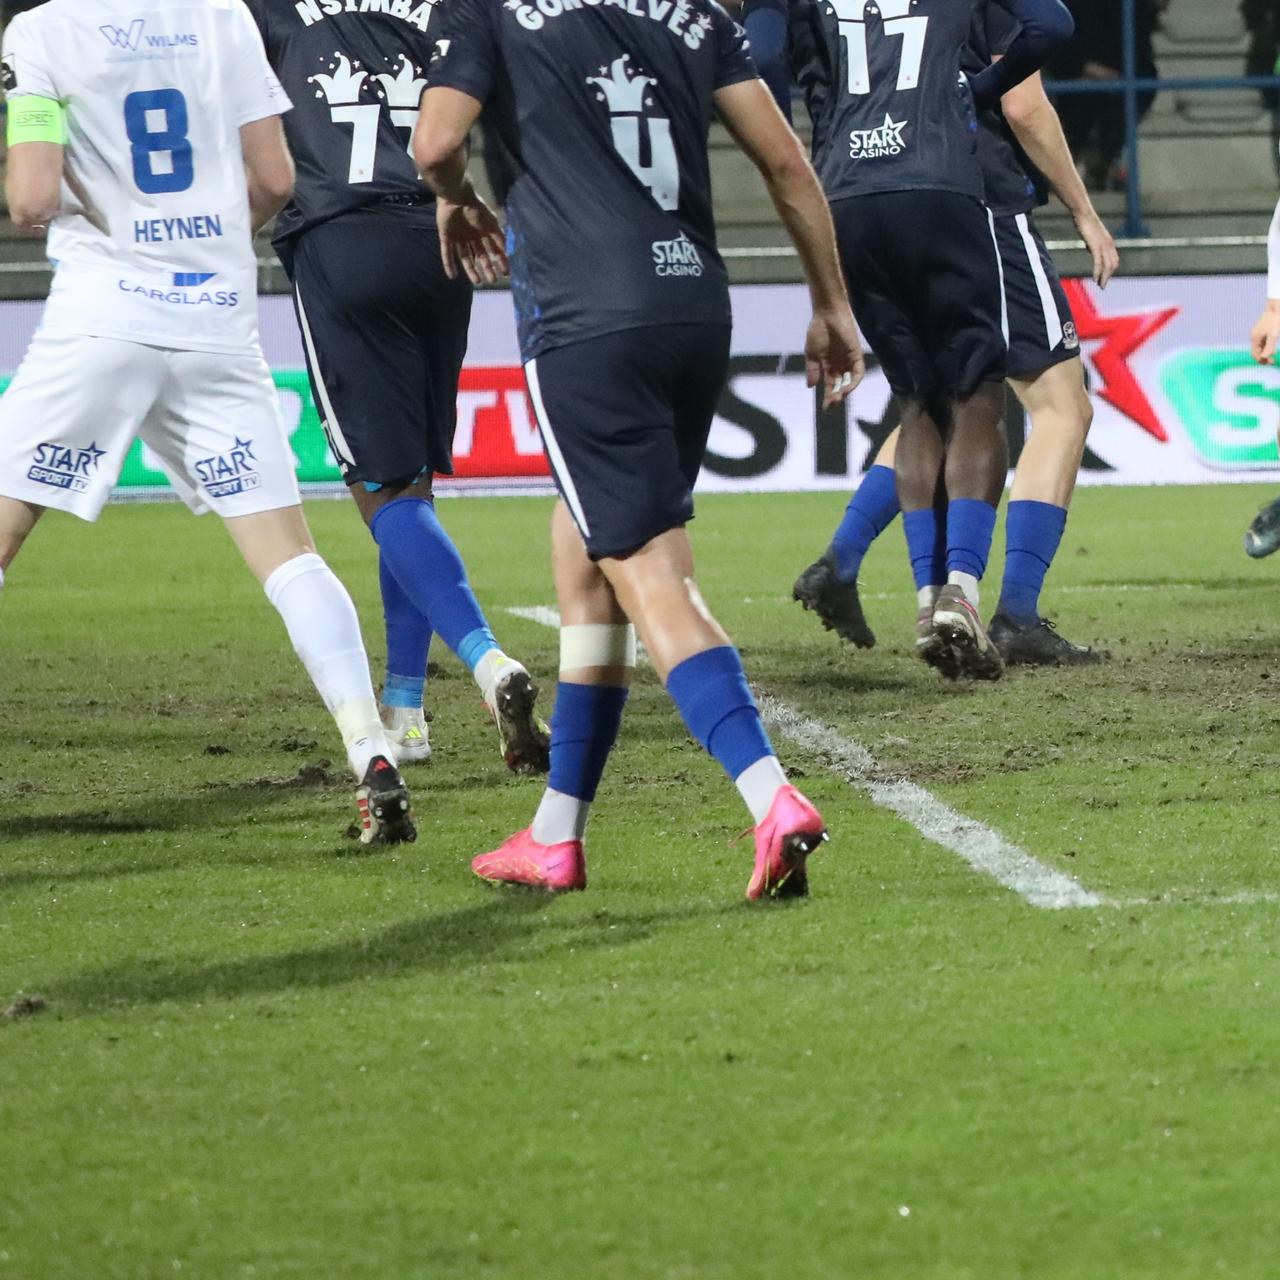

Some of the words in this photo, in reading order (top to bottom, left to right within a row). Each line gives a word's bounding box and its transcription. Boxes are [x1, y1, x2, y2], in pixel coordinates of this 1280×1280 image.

[145, 33, 198, 48] WILMS
[838, 16, 929, 95] 17
[124, 88, 194, 195] 8
[850, 128, 901, 150] STAR
[610, 117, 679, 211] 4
[850, 147, 900, 160] CASINO
[135, 214, 222, 243] HEYNEN
[653, 241, 701, 265] STAR
[655, 264, 701, 277] CASINO
[118, 279, 239, 307] CARGLASS
[33, 442, 92, 476] STAR
[194, 450, 251, 483] STAR
[29, 468, 71, 487] SPORT
[73, 480, 89, 490] TV
[243, 475, 257, 487] TV
